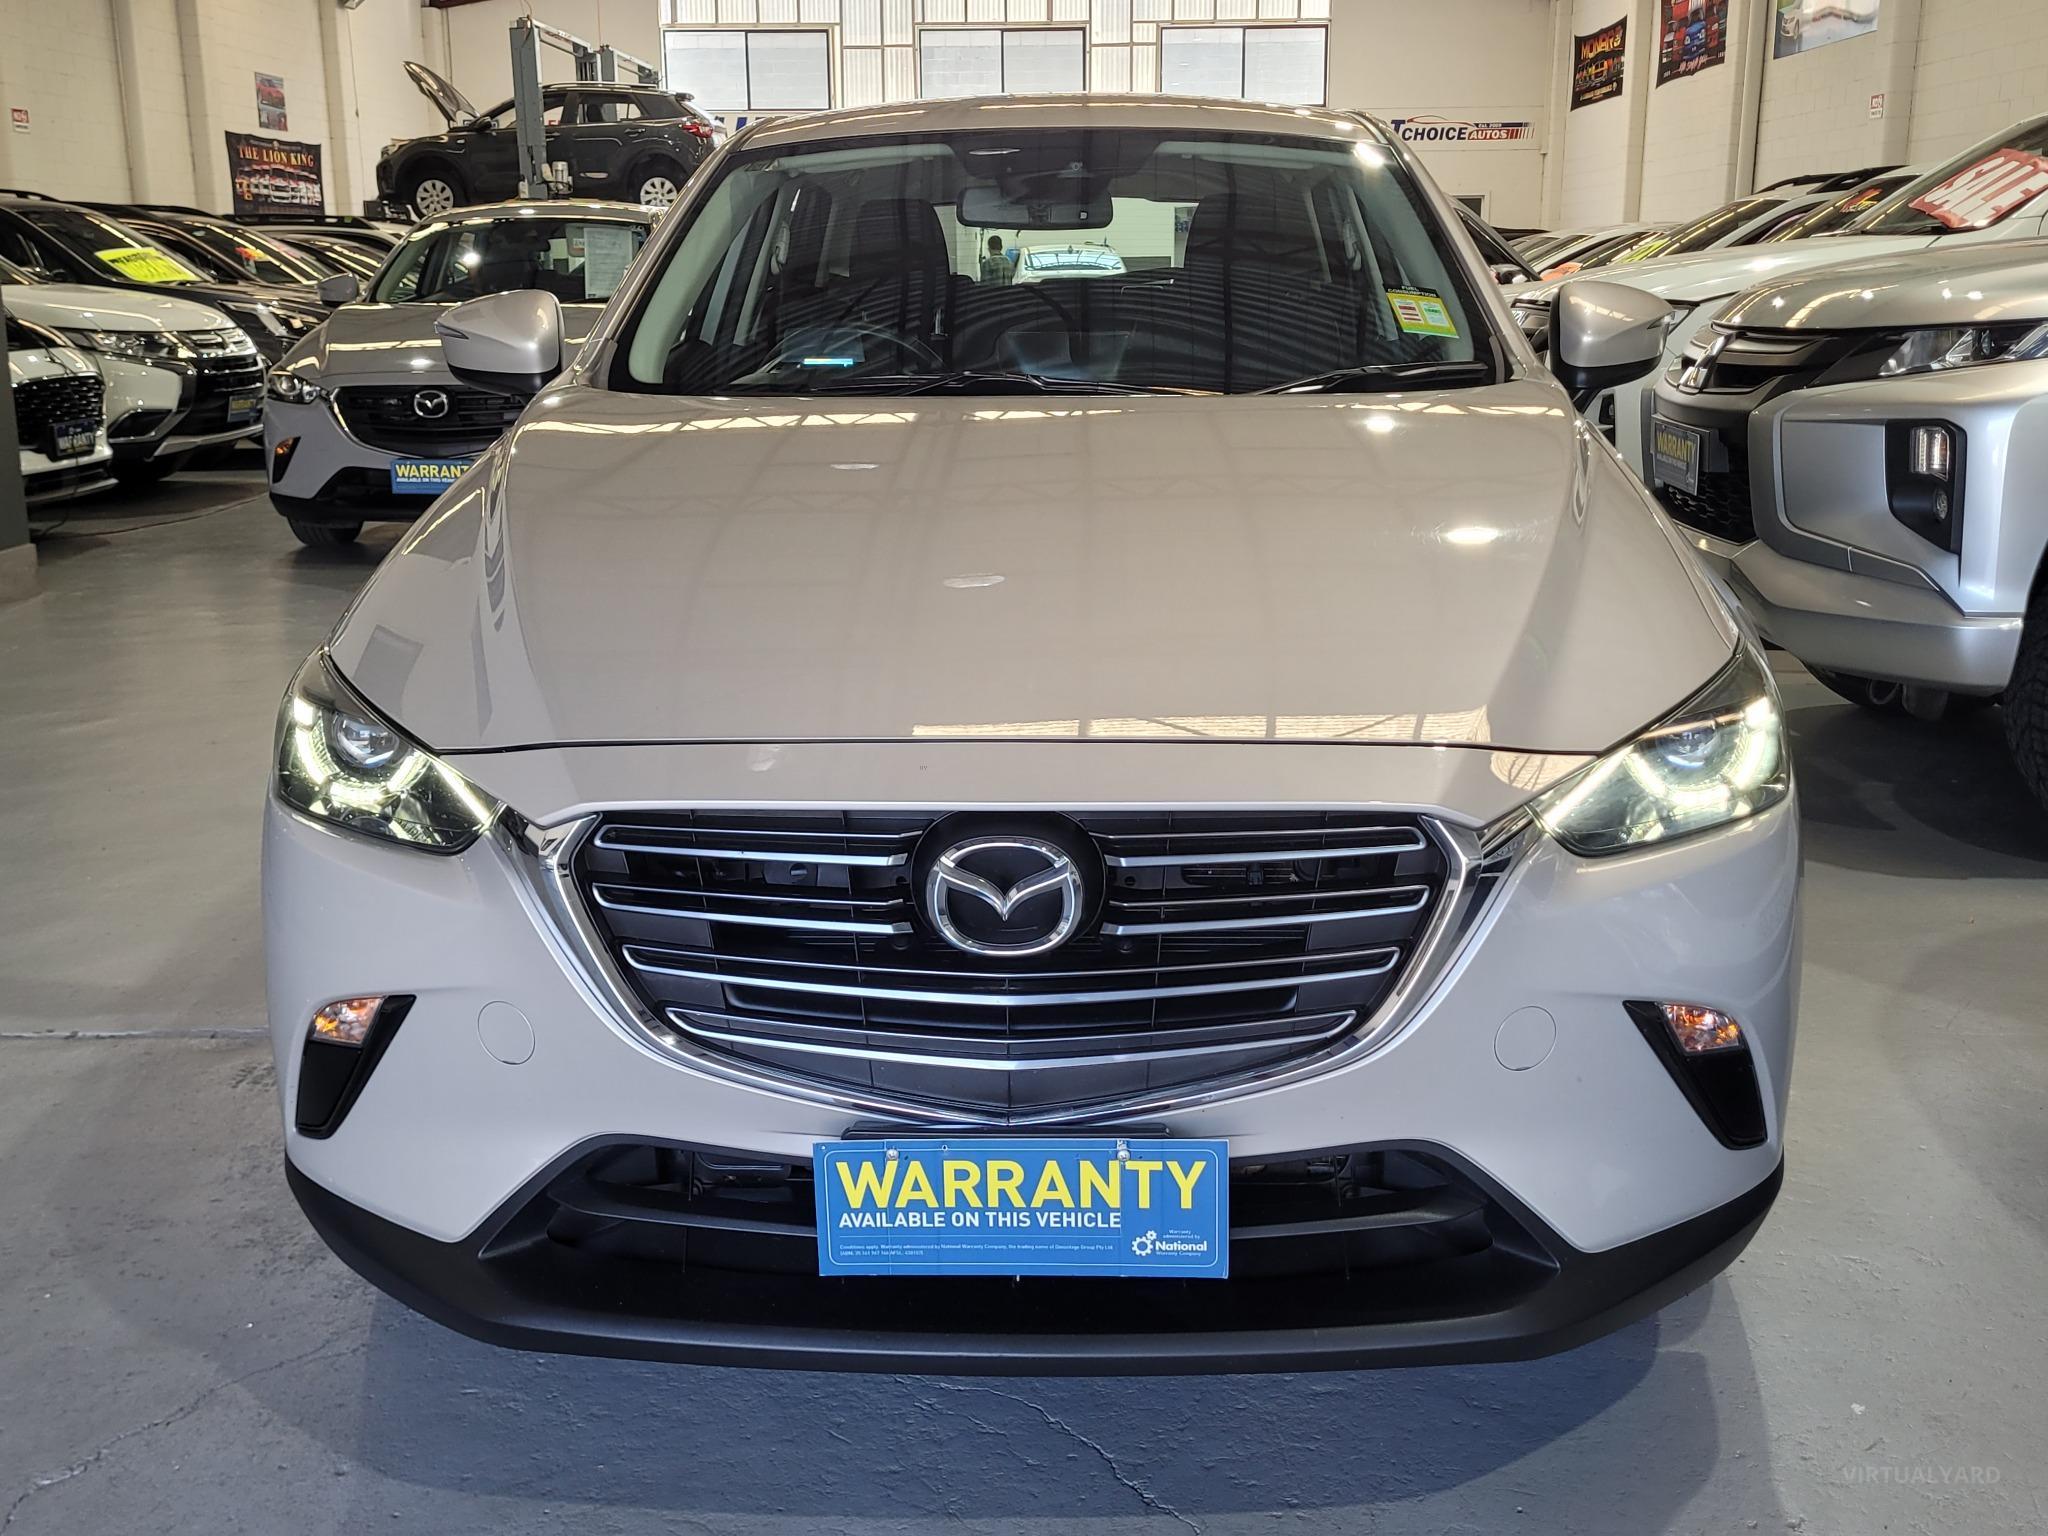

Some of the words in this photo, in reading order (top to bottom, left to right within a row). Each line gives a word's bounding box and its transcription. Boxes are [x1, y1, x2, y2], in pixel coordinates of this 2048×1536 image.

[1401, 127, 1468, 141] CHOICE
[1469, 129, 1508, 140] AUTOS
[237, 145, 259, 160] THE
[261, 149, 288, 164] LION
[290, 153, 314, 167] KING
[1924, 156, 2048, 227] SALE
[1656, 430, 1697, 464] WARRANTY
[835, 1159, 1208, 1209] WARRANTY
[839, 1212, 946, 1228] AVAILABLE
[951, 1212, 980, 1228] ON
[985, 1212, 1031, 1228] THIS
[1036, 1212, 1121, 1228] VEHICLE
[1155, 1240, 1207, 1251] National
